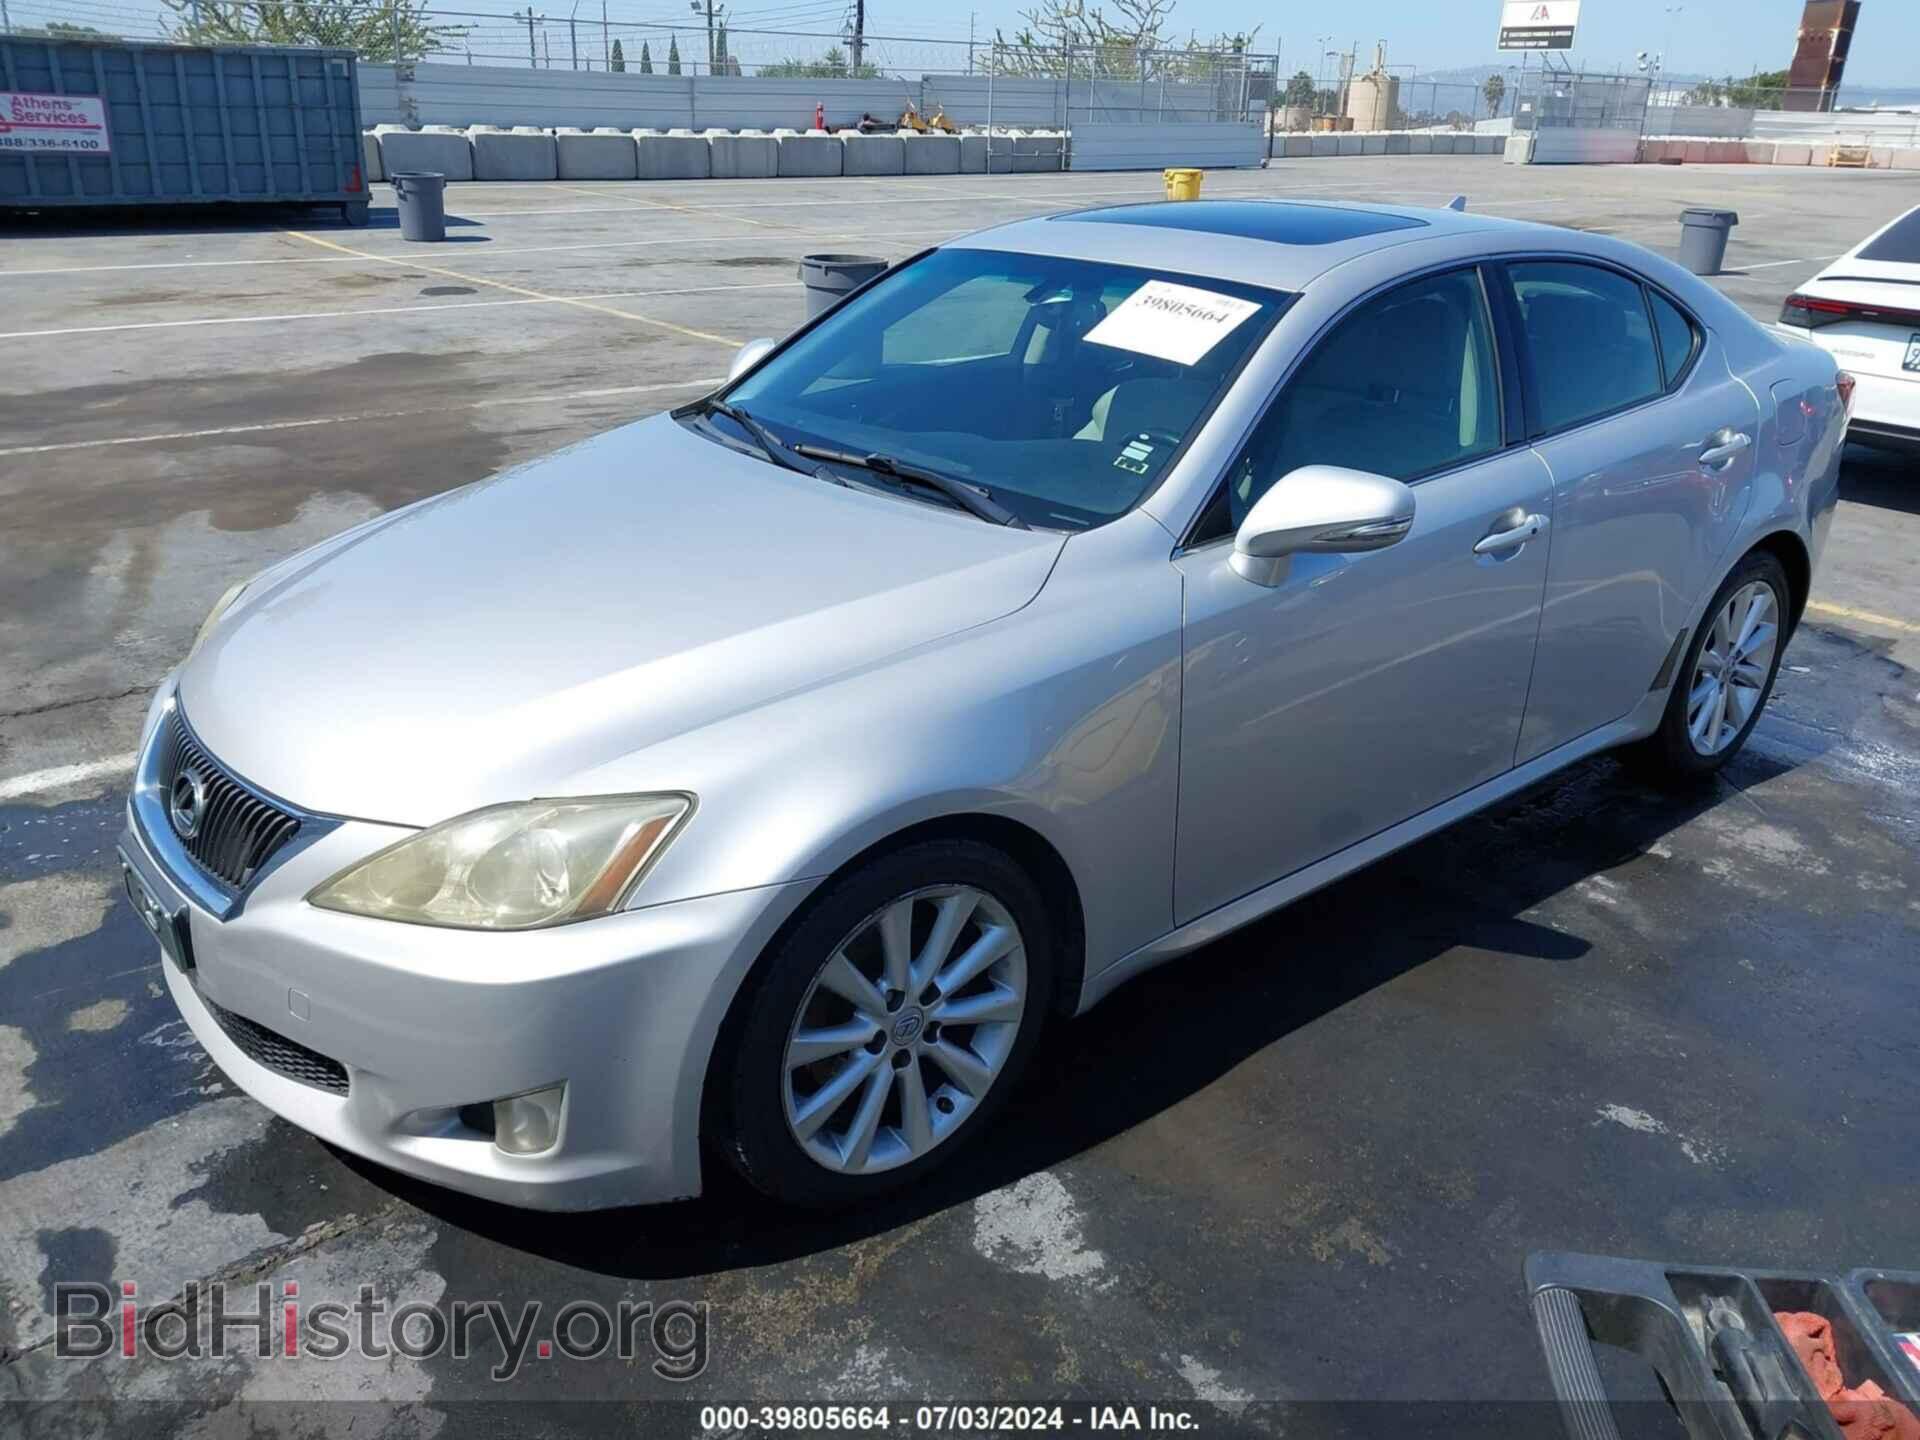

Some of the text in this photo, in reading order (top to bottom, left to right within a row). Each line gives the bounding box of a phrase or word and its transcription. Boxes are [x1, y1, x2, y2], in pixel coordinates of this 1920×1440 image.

[11, 96, 73, 110] Athens
[11, 108, 88, 123] Services
[1135, 295, 1230, 324] 39805664
